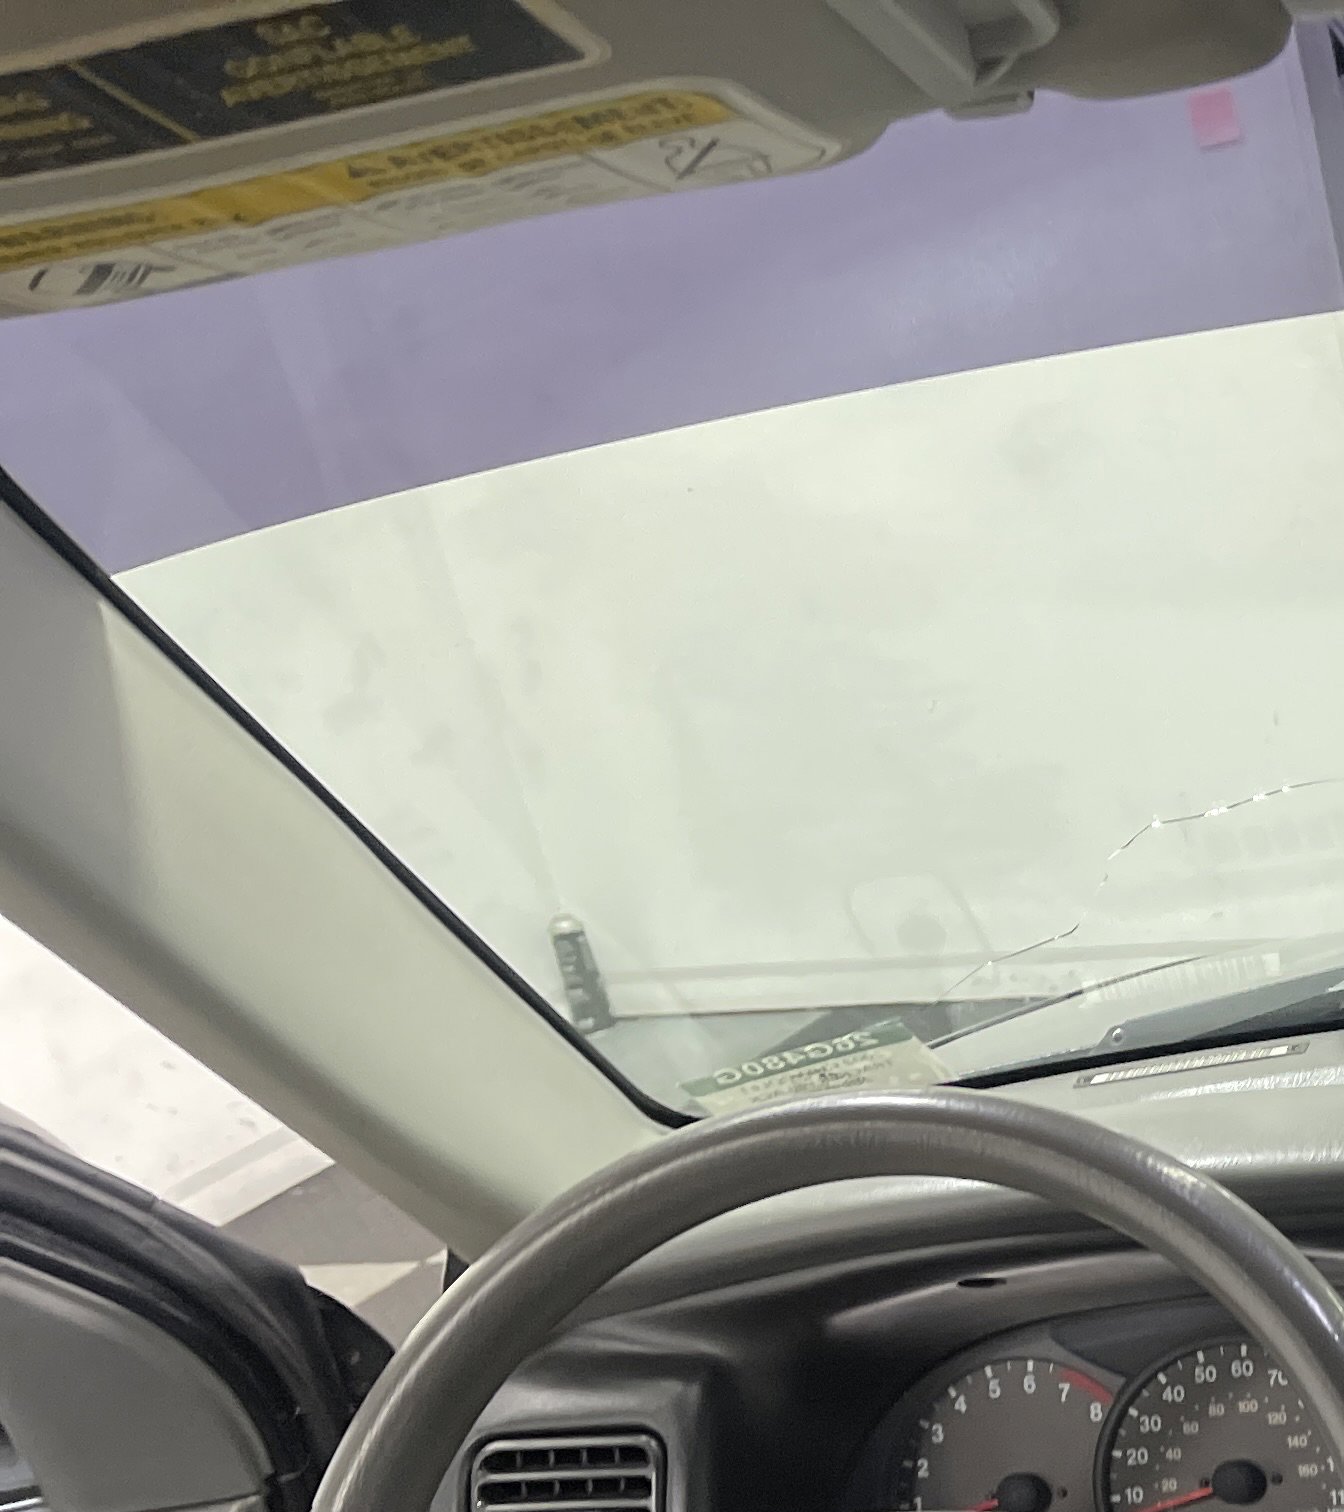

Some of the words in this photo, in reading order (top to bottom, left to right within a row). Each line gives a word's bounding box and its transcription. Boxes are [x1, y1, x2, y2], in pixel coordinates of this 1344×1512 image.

[1194, 1364, 1217, 1384] 50
[1231, 1359, 1254, 1378] 60
[988, 1378, 1001, 1399] 5
[1023, 1374, 1036, 1395] 6
[1058, 1383, 1071, 1403] 7
[1162, 1384, 1185, 1404] 40
[954, 1394, 967, 1415] 4
[1090, 1402, 1103, 1422] 8
[1238, 1399, 1259, 1413] 100
[1139, 1413, 1162, 1434] 30
[1182, 1420, 1199, 1436] 60
[1267, 1411, 1288, 1426] 120
[931, 1423, 944, 1444] 3
[1287, 1434, 1308, 1449] 140
[1126, 1447, 1149, 1467] 20
[1165, 1447, 1182, 1462] 40
[917, 1457, 929, 1479] 2
[1161, 1477, 1178, 1493] 20
[1124, 1486, 1144, 1505] 10
